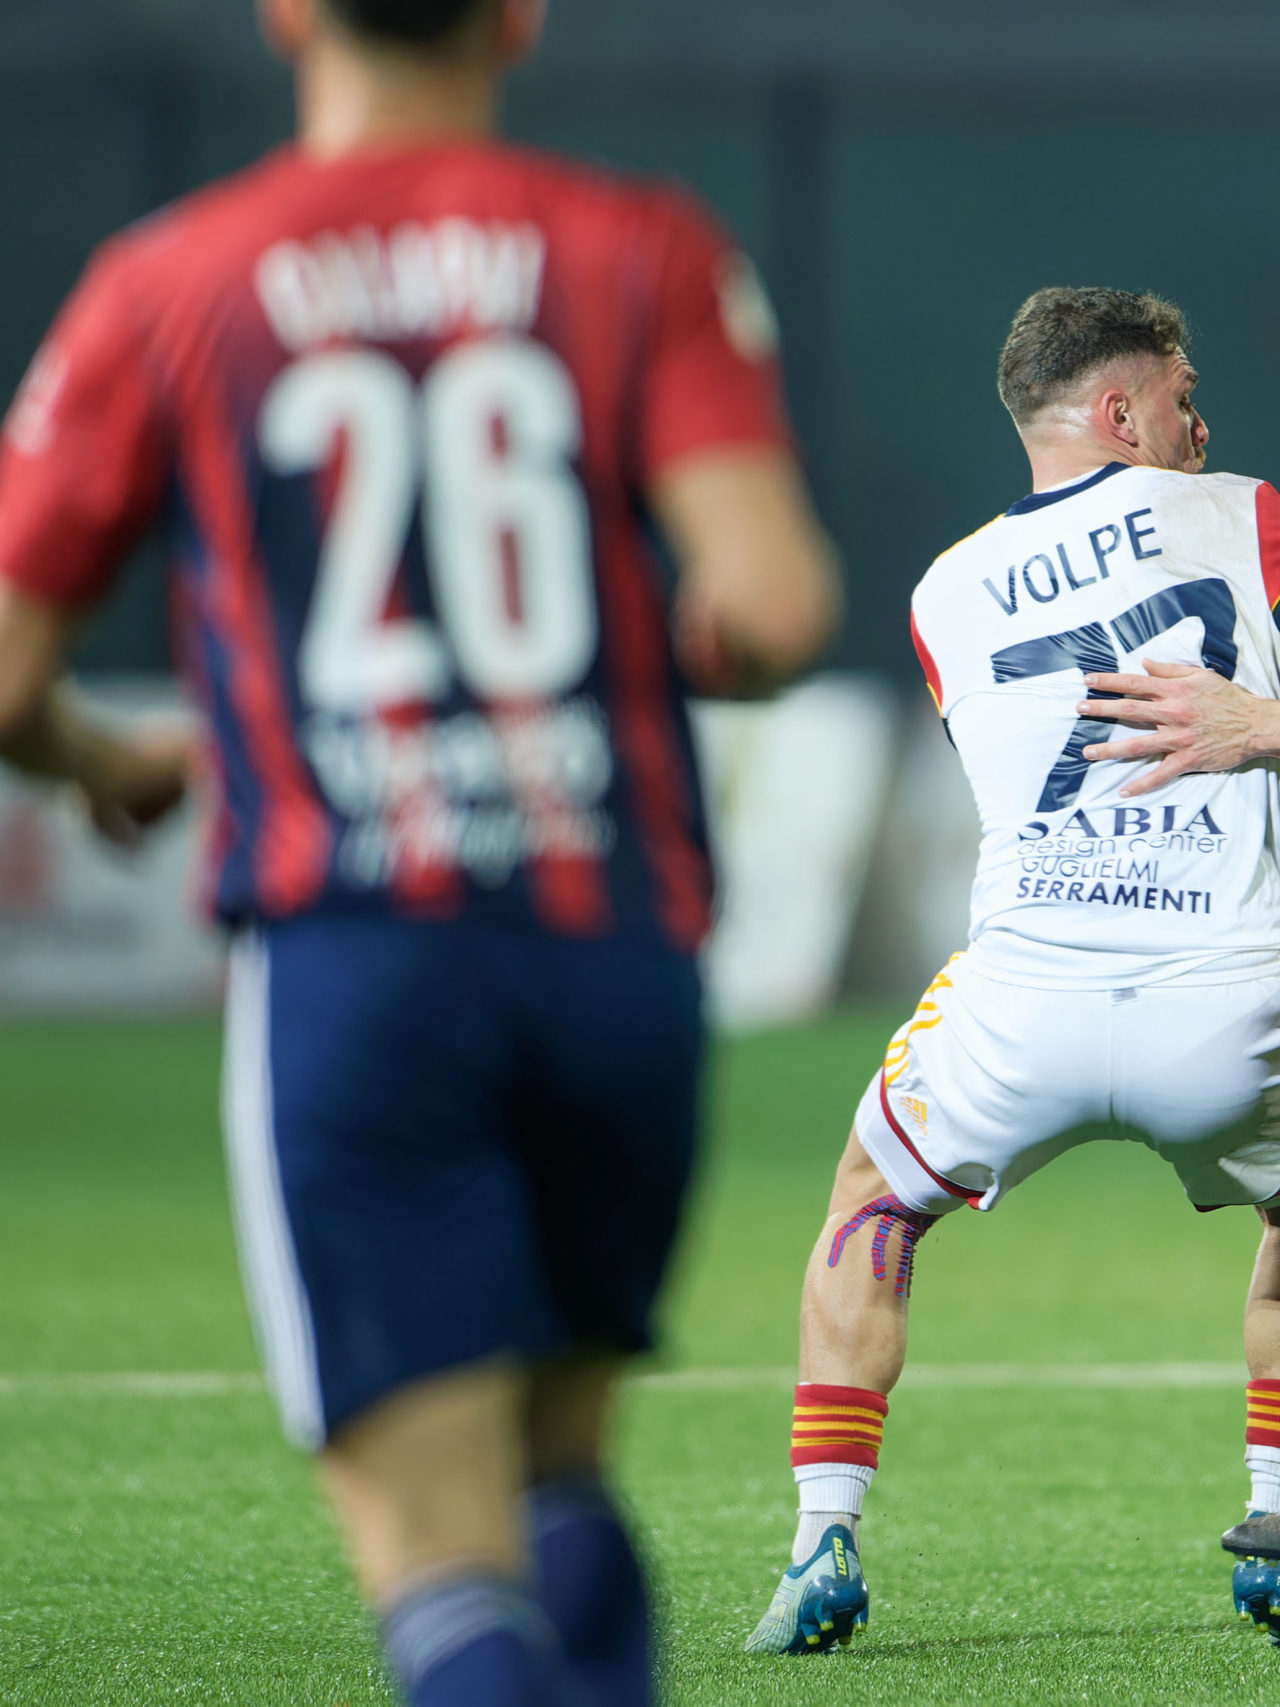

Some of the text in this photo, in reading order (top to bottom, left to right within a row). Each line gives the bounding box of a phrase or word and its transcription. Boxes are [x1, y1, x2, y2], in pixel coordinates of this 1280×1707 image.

[258, 337, 598, 712] 26
[982, 507, 1163, 616] VOLPE
[1018, 804, 1229, 841] SABIA
[1017, 831, 1228, 857] design center
[1021, 855, 1159, 883] GUGLIELMI
[1016, 876, 1212, 914] SERRAMENTI
